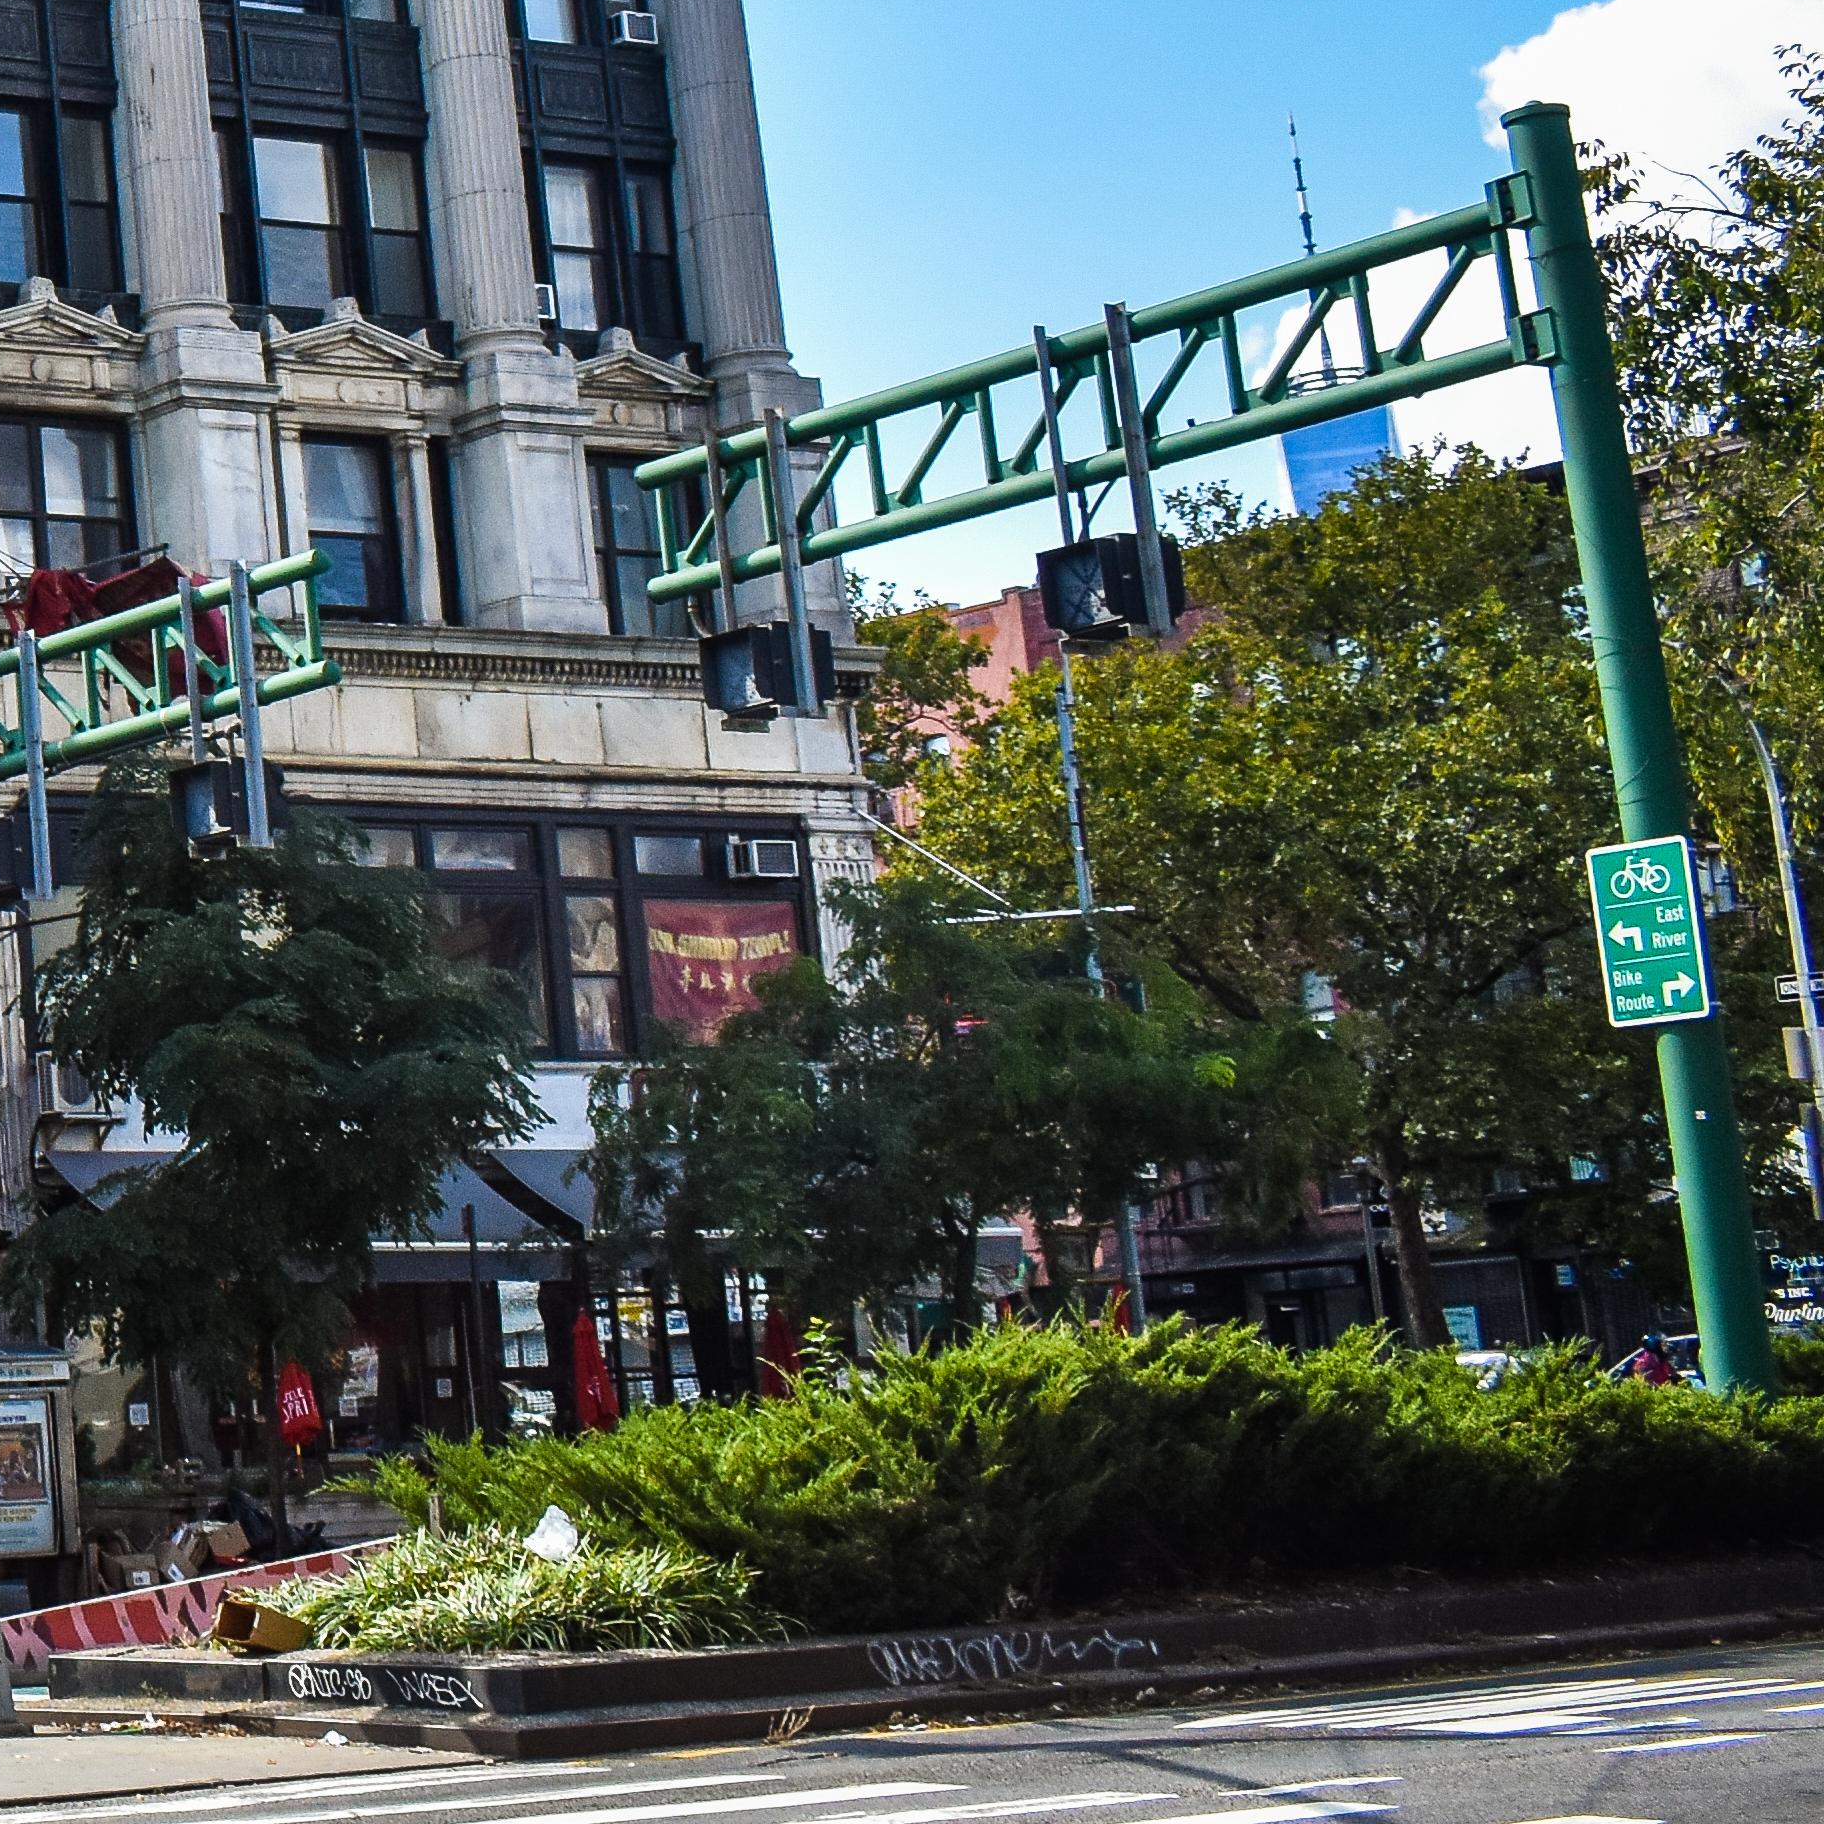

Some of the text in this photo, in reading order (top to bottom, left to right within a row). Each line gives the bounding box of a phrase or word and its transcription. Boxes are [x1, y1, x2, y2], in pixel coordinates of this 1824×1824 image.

[1655, 903, 1686, 925] East
[1652, 931, 1688, 950] River
[1613, 970, 1643, 988] Bike
[1617, 992, 1655, 1014] Route
